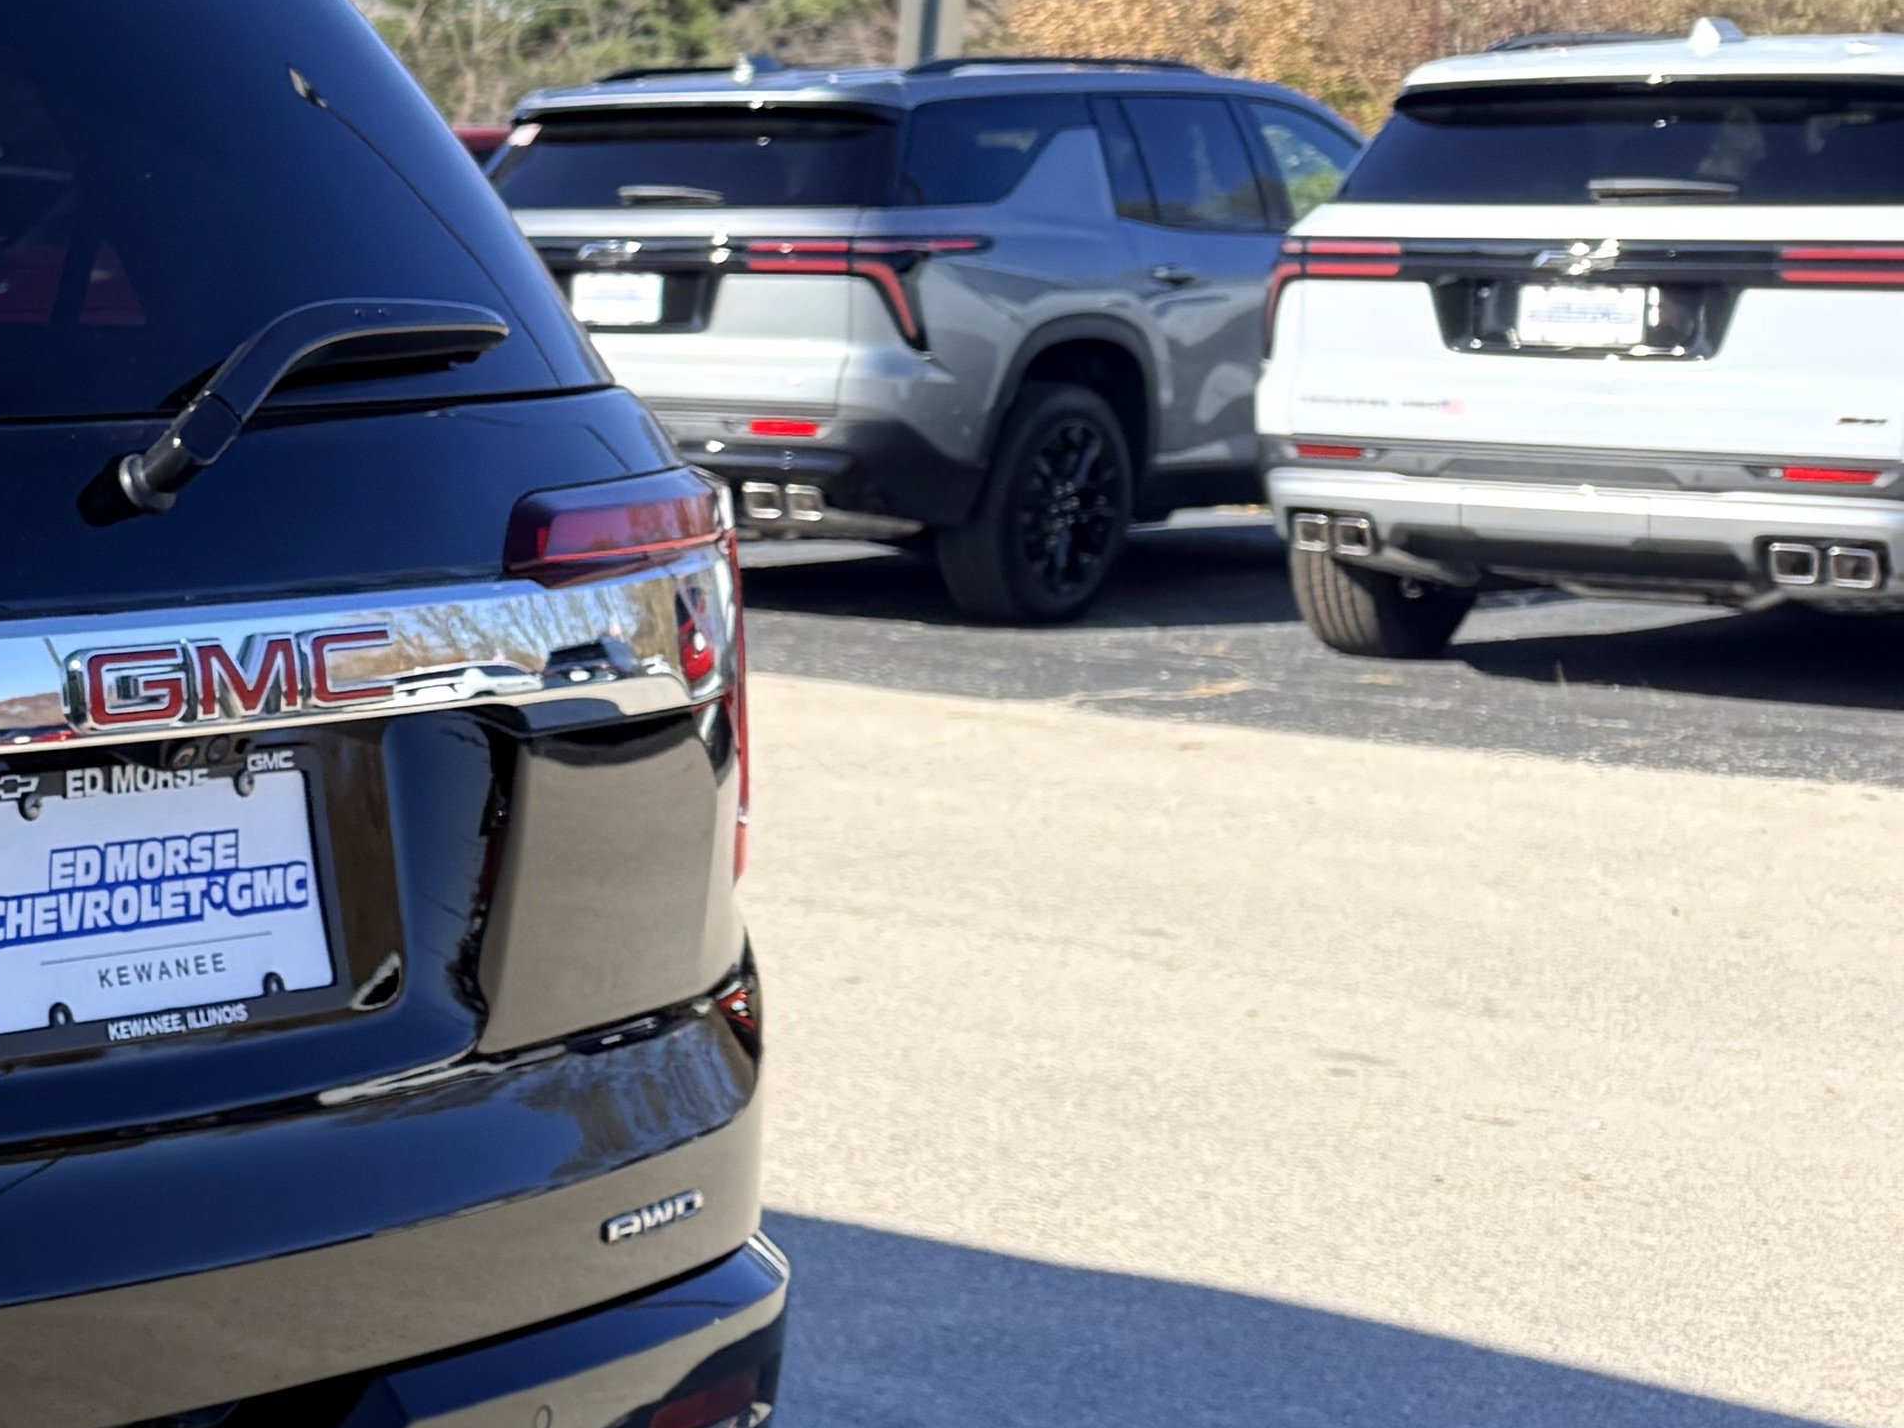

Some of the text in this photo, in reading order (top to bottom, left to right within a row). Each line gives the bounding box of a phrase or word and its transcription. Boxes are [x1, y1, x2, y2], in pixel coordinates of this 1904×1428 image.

[72, 622, 395, 731] GMC
[247, 750, 295, 772] GMC
[66, 767, 104, 799] ED
[50, 830, 239, 890] ED MORSE
[98, 952, 227, 989] KEWANEE
[107, 1003, 250, 1042] KEWANEE, ILLINOIS
[600, 1189, 705, 1244] AWD
